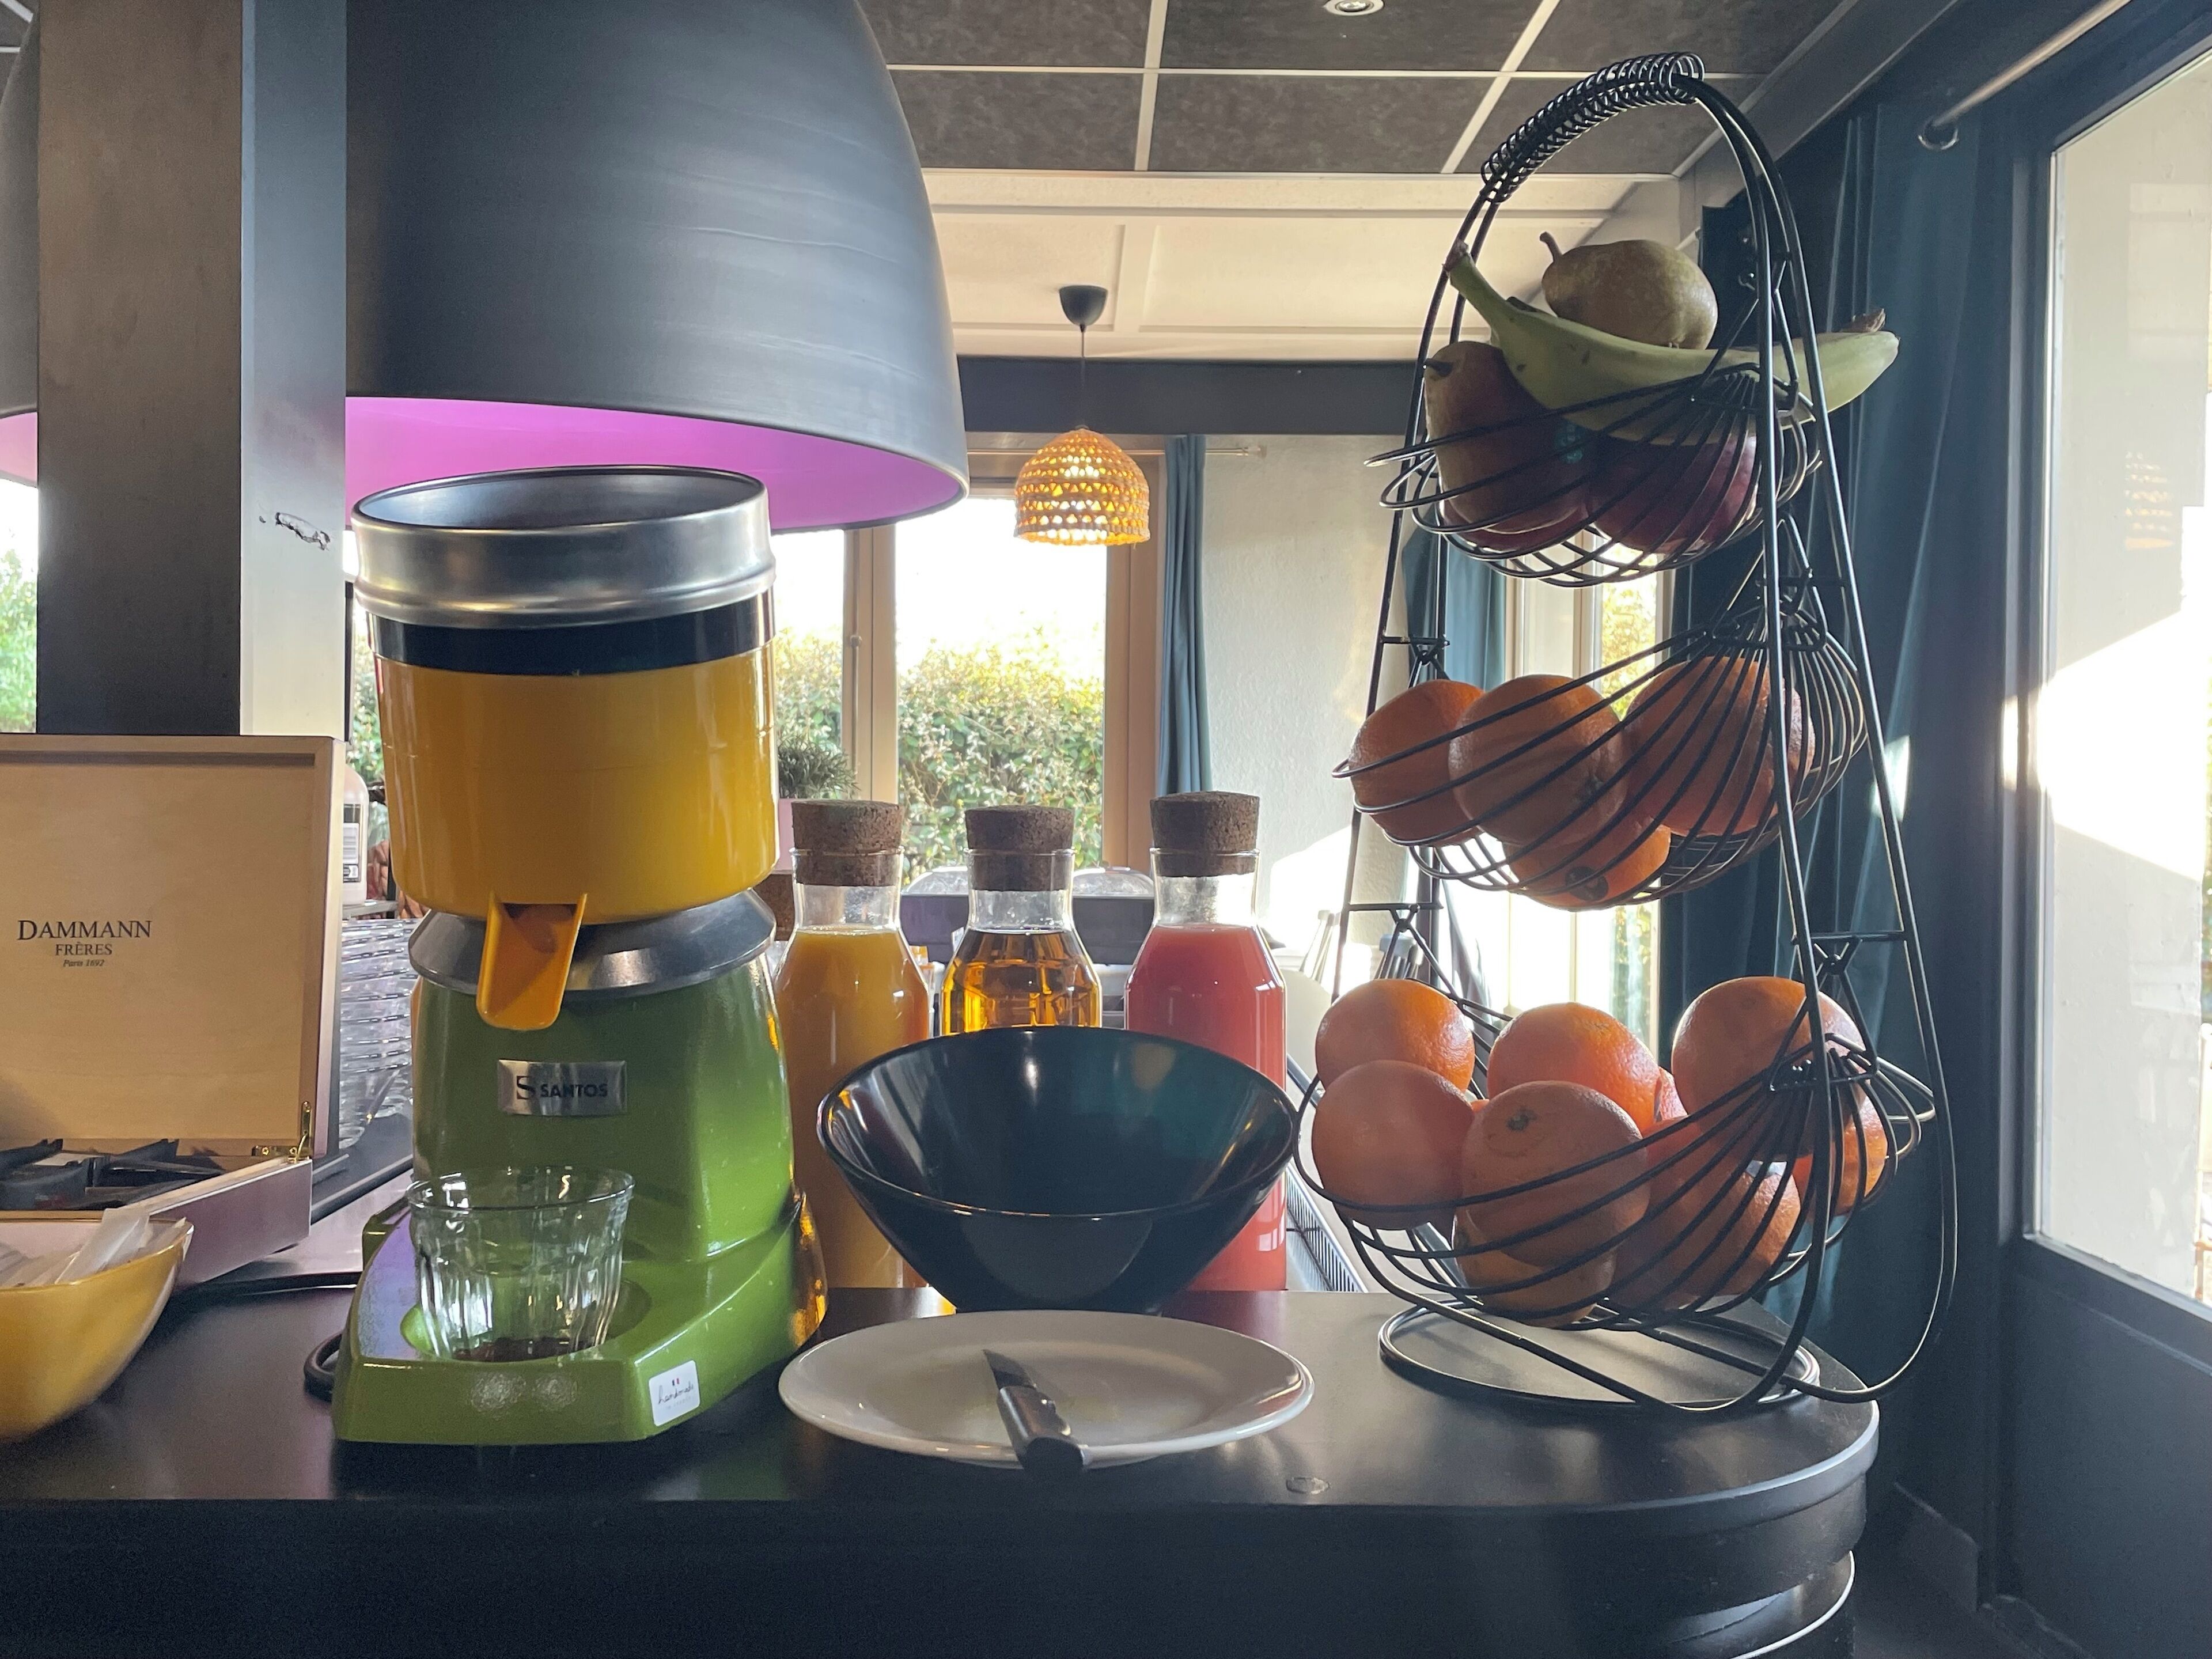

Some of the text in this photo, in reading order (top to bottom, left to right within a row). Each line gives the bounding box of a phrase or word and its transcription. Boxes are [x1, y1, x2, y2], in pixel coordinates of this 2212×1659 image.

[17, 920, 152, 940] DAMMANN
[55, 941, 113, 956] FRÈRES
[63, 959, 84, 967] Paris
[540, 1084, 608, 1097] SANTOS
